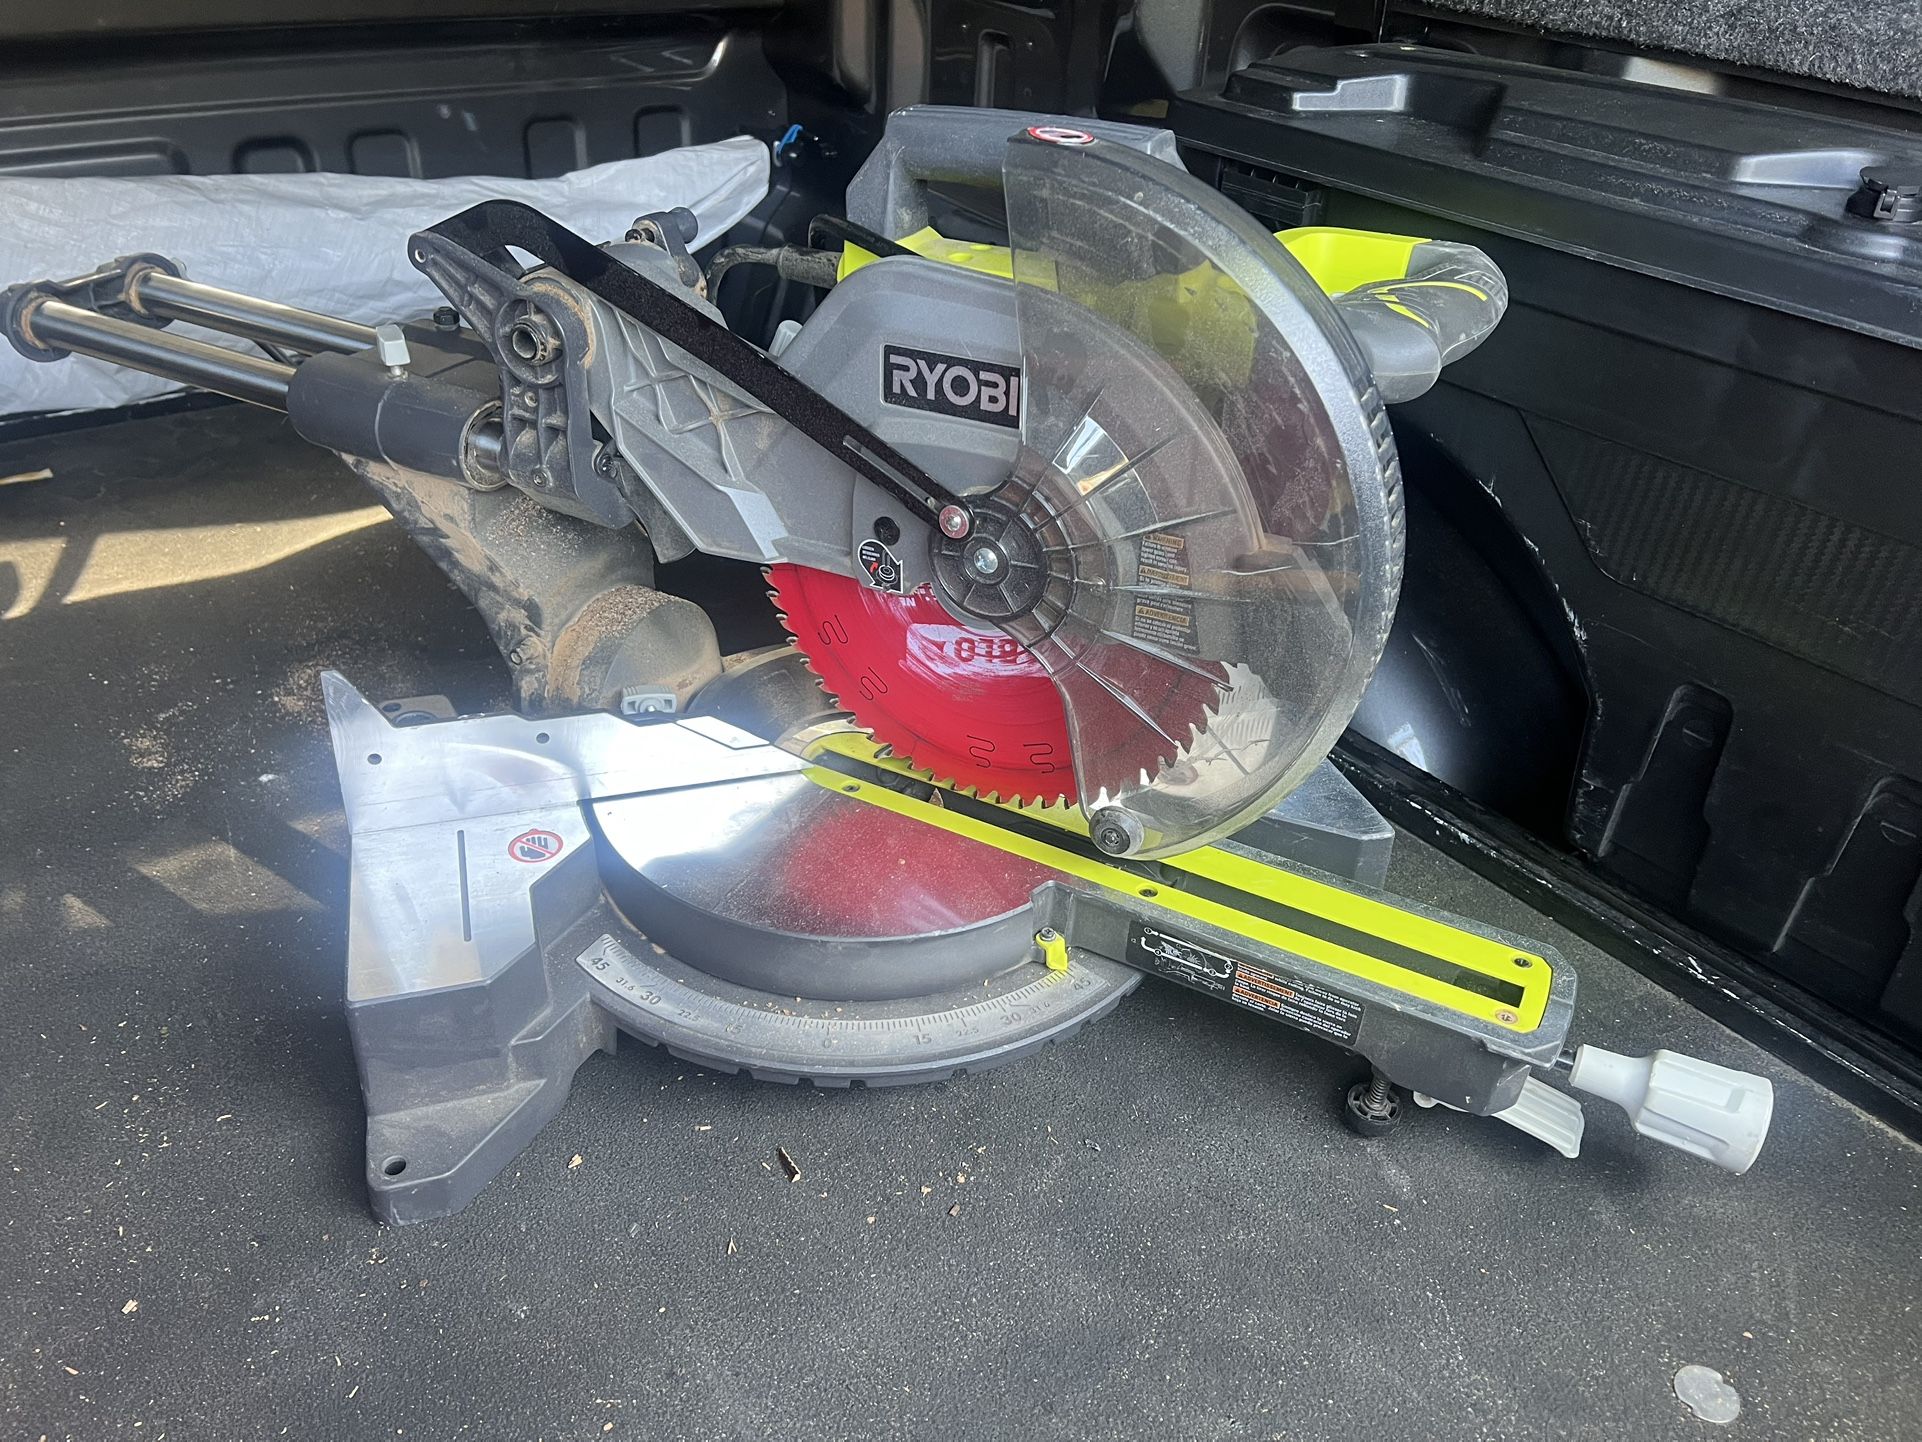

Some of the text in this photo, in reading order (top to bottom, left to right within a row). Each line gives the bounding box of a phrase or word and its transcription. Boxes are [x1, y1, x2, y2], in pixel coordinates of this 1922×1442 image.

[889, 354, 1019, 417] RYOBI
[591, 957, 610, 971] 45
[616, 977, 636, 991] 31.6
[1074, 979, 1091, 991] 45
[640, 990, 661, 1005] 30
[678, 1009, 701, 1021] 22.5
[1000, 1013, 1022, 1026] 30
[912, 1033, 932, 1045] 15
[956, 1027, 979, 1038] 22.5
